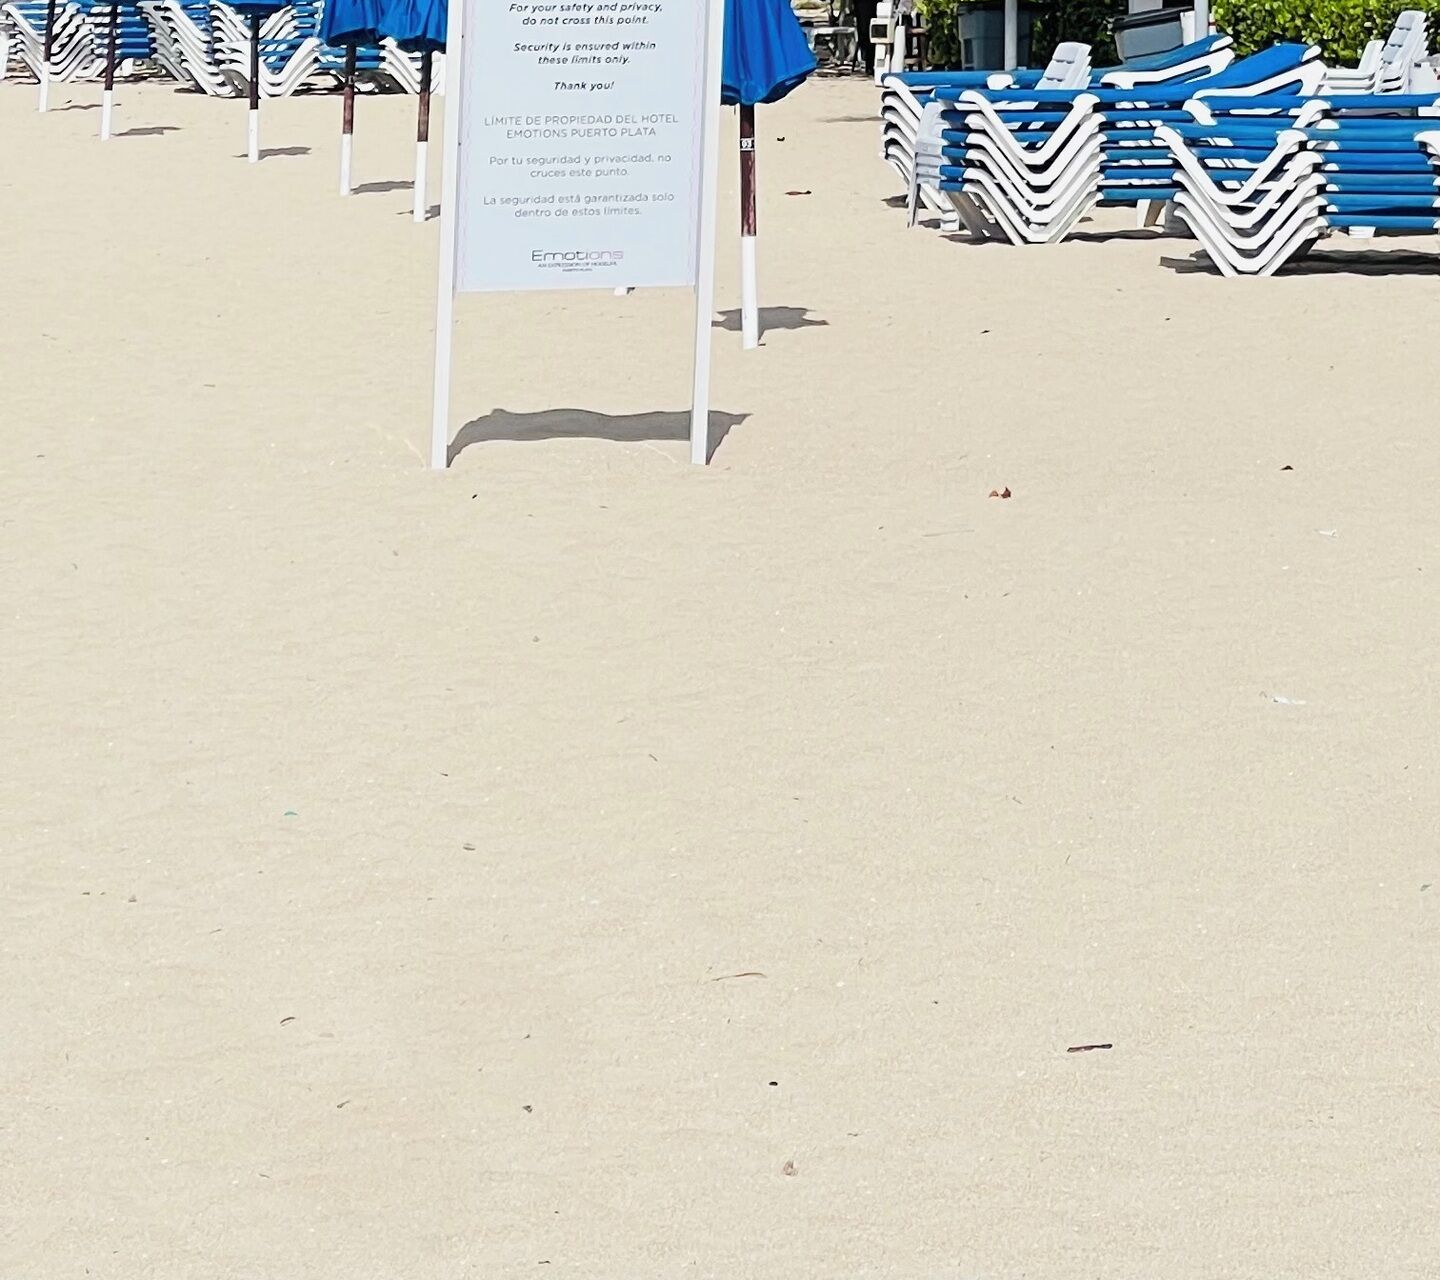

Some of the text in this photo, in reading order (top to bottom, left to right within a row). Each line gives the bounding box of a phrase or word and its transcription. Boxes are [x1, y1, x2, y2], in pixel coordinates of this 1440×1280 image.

[508, 3, 529, 14] For
[531, 2, 557, 14] your
[559, 2, 594, 13] safety
[596, 2, 618, 13] and
[521, 17, 537, 27] do
[539, 16, 559, 27] not
[562, 15, 591, 25] cross
[594, 15, 614, 24] this
[513, 41, 656, 53] Security is ensured within
[537, 54, 631, 65] these limits only.
[553, 80, 615, 91] Thank you!
[484, 113, 679, 126] LÍMITE DE PROPIEDAD DEL HOTEL
[507, 127, 656, 140] EMOTIONS PUERTO PLATA
[490, 156, 508, 165] Por
[512, 157, 523, 167] tu
[526, 155, 581, 167] seguridad
[584, 156, 591, 165] y
[658, 153, 671, 163] no
[530, 169, 566, 178] cruces
[569, 169, 592, 177] este
[484, 194, 674, 206] La seguridad está garantizada solo
[515, 207, 642, 218] dentro de estos límites.
[531, 249, 624, 262] Emotions
